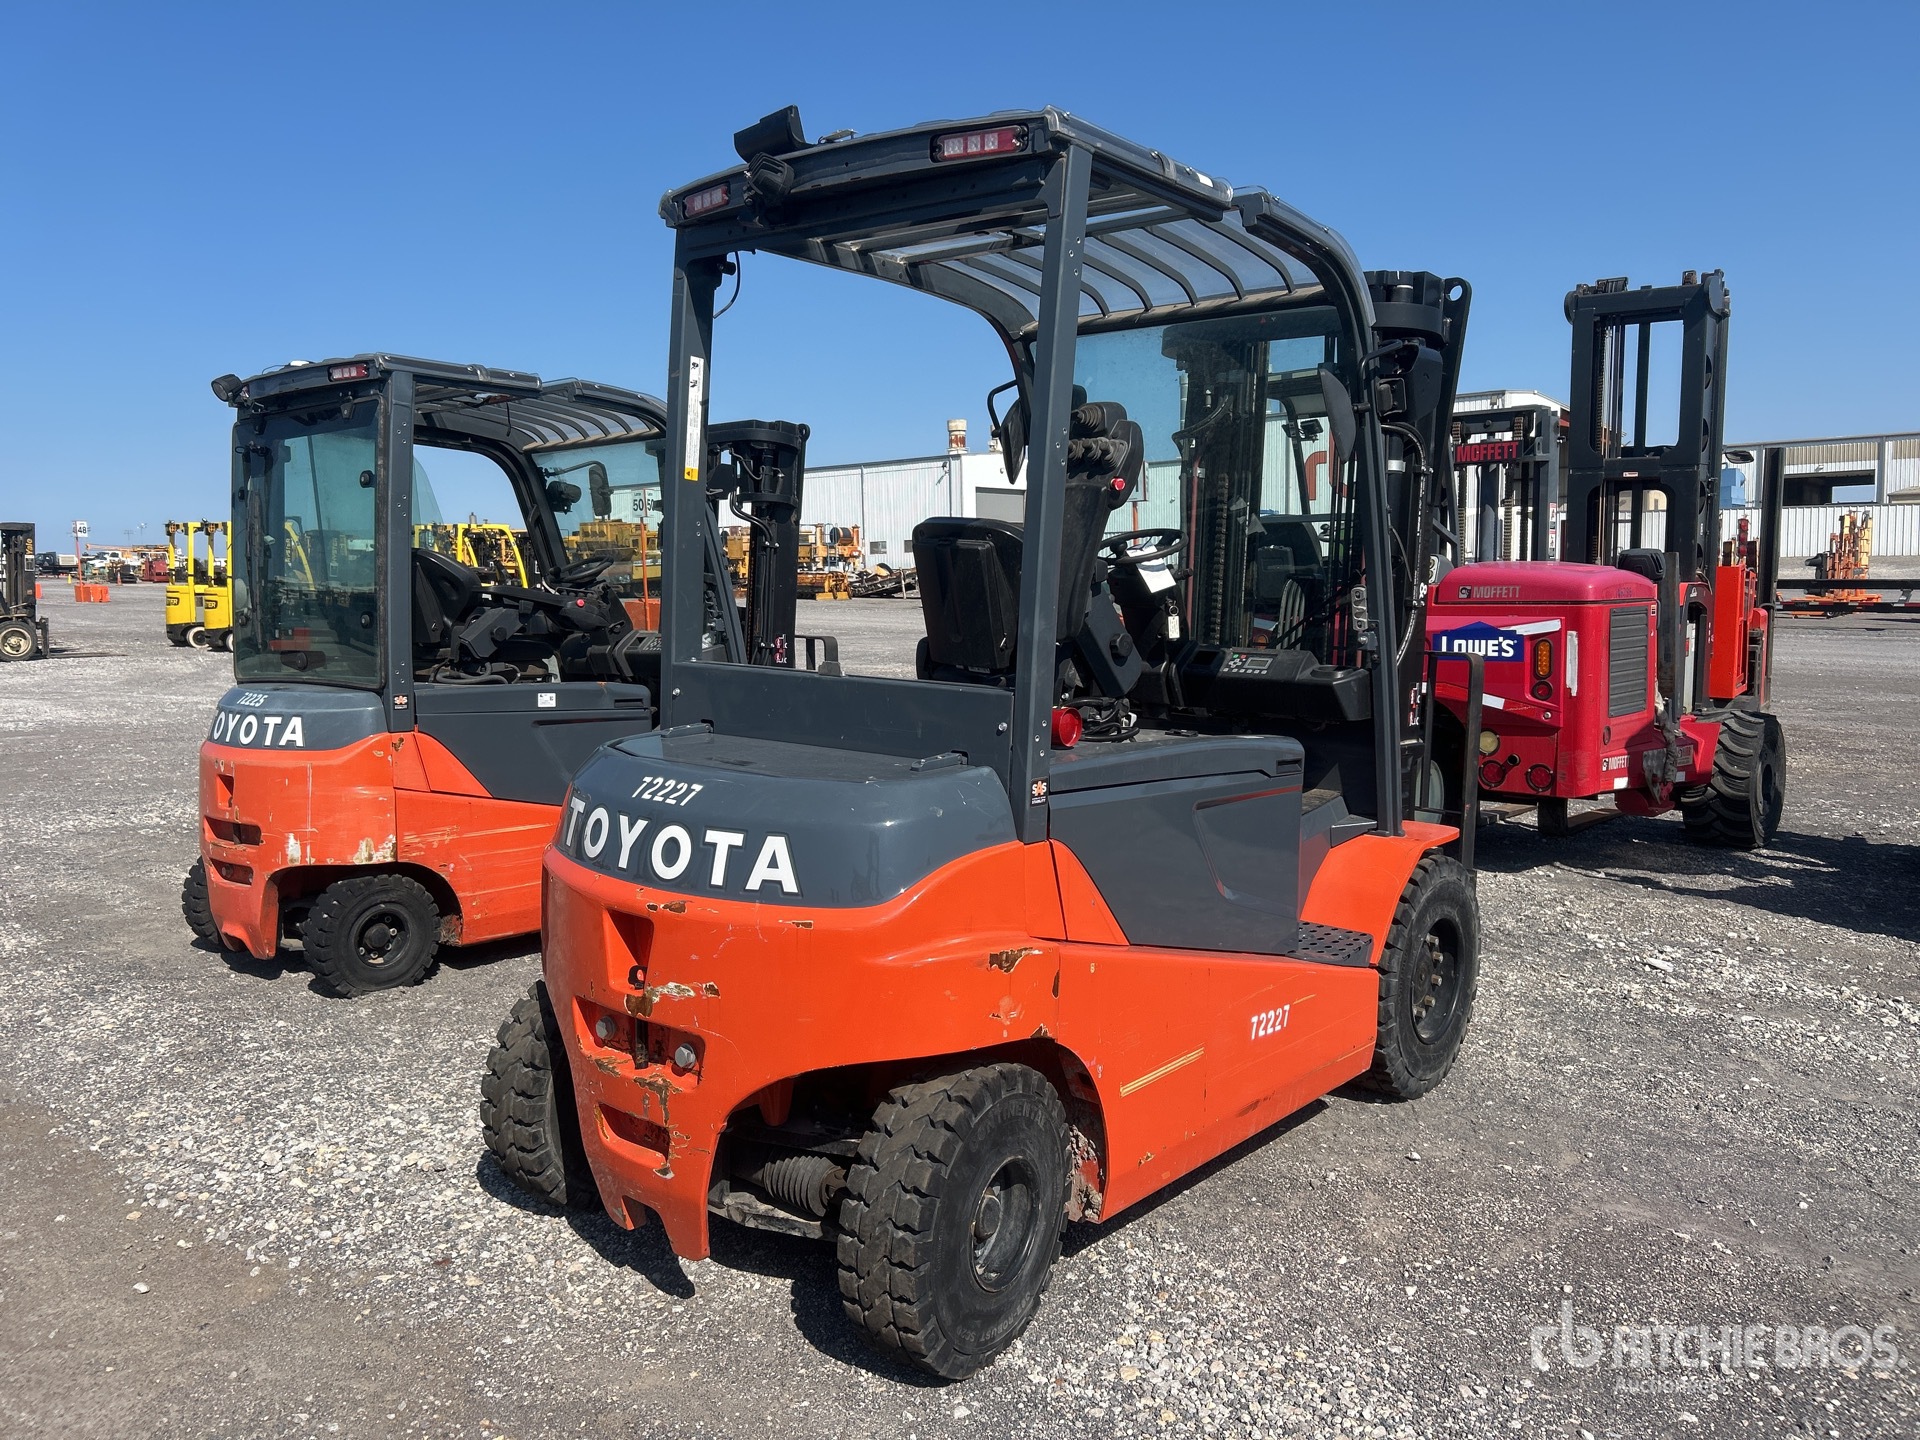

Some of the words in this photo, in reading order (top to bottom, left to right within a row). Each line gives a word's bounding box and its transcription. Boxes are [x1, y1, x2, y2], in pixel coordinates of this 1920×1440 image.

[1456, 442, 1519, 462] MOFFETT
[632, 499, 644, 512] 50
[1473, 586, 1521, 598] MOFFETT
[237, 692, 268, 707] 72225
[1609, 756, 1630, 770] MOFFETT
[632, 776, 703, 807] 72227
[1032, 781, 1047, 796] SAS
[565, 796, 799, 893] TOYOTA
[1250, 1003, 1290, 1041] 72227
